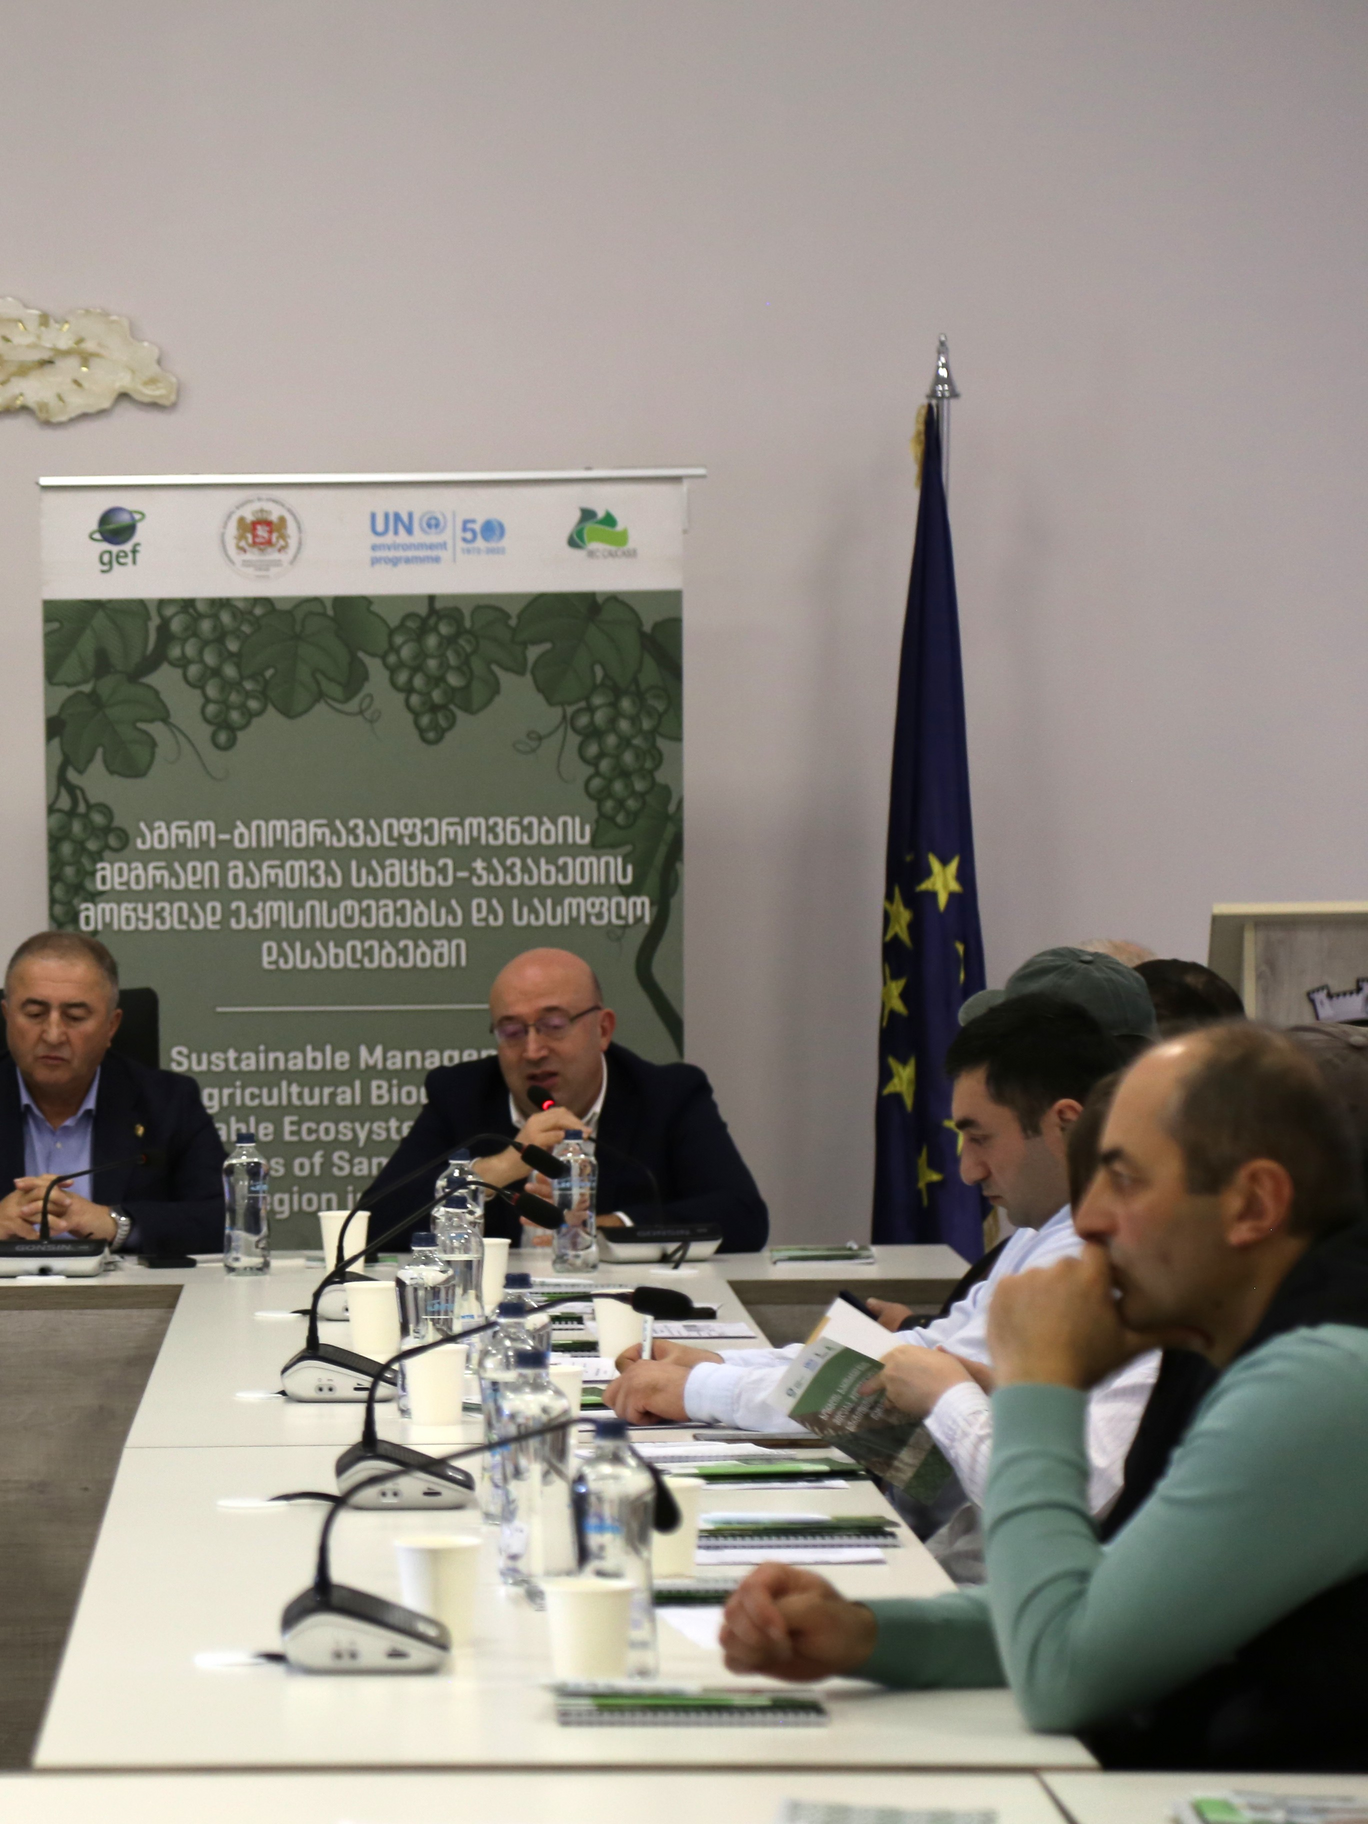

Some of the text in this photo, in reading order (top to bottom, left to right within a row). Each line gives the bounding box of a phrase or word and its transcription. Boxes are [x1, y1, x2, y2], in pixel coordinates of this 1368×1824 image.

[370, 511, 414, 537] UN
[98, 542, 141, 574] gef
[370, 541, 448, 553] environment
[370, 555, 442, 568] programme
[227, 859, 343, 890] მართვა
[471, 898, 504, 927] და
[170, 1043, 351, 1072] Sustainable
[201, 1079, 362, 1114] gricultural
[283, 1115, 416, 1148] Ecosyste
[293, 1150, 324, 1177] of
